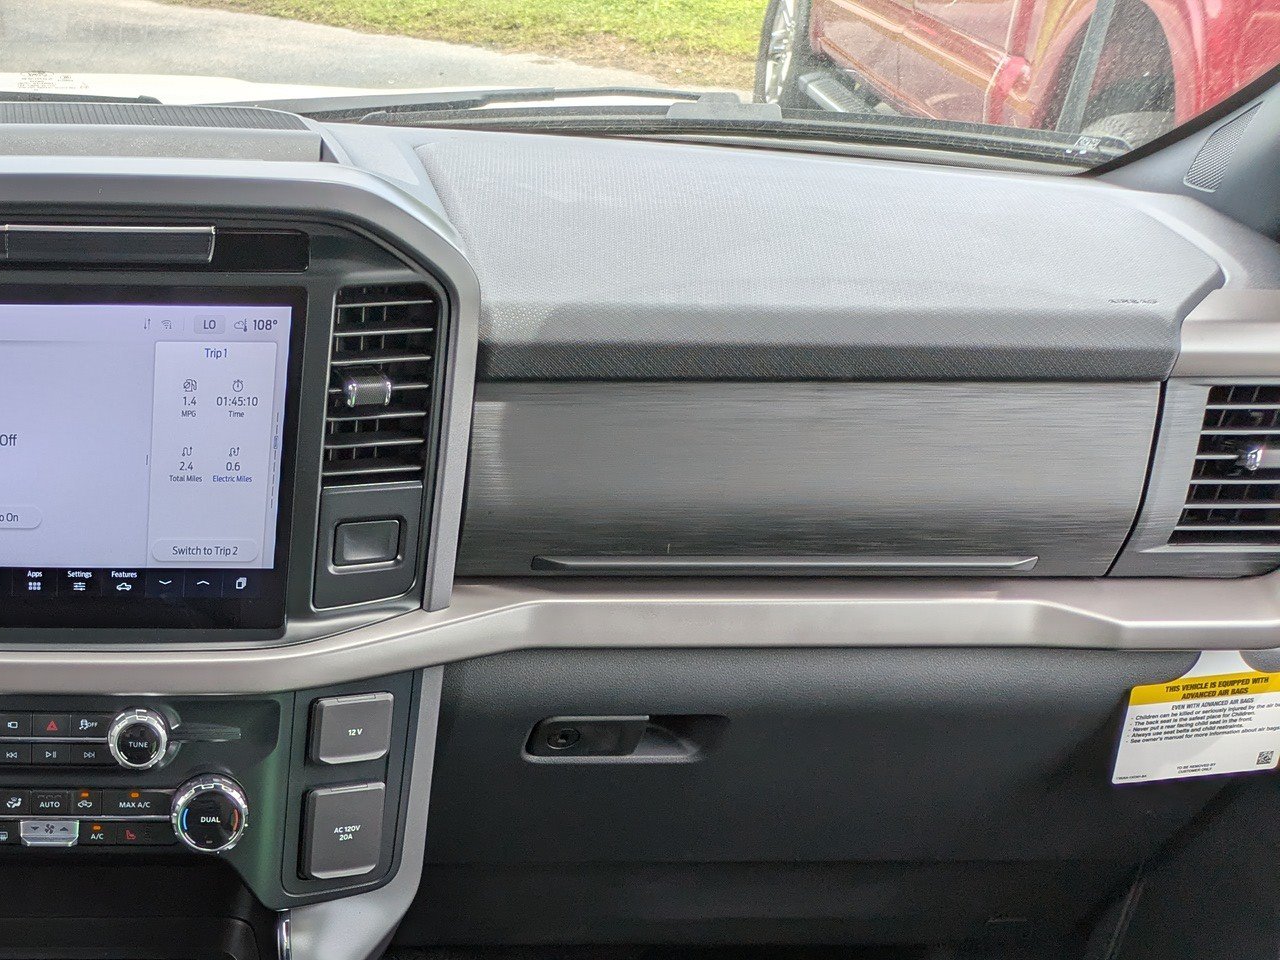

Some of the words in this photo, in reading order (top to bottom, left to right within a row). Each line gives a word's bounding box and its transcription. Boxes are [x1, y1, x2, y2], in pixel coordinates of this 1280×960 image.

[203, 319, 217, 330] LO
[253, 319, 278, 331] 108°
[204, 347, 222, 359] Trip
[223, 348, 228, 358] 1
[182, 396, 197, 406] 1.4
[216, 396, 259, 407] 01:45:10
[181, 410, 197, 418] MPG
[228, 410, 245, 418] Time
[0, 433, 18, 447] Off
[179, 461, 194, 471] 2.4
[225, 461, 241, 471] 0.6
[169, 474, 186, 482] Total
[186, 474, 203, 483] Miles
[212, 475, 236, 483] Electric
[236, 475, 253, 483] Miles
[6, 512, 19, 522] On
[172, 545, 202, 556] Switch
[203, 546, 213, 556] to
[214, 546, 231, 557] Trip
[232, 546, 239, 556] 2
[27, 570, 43, 578] Apps
[67, 570, 93, 579] Settings
[111, 570, 138, 578] Features
[1182, 682, 1209, 691] VEHICLE
[1218, 678, 1251, 688] EQUIPPED
[1252, 676, 1269, 685] WITH
[1181, 690, 1217, 700] ADVANCED
[1231, 687, 1249, 695] BAGS
[348, 728, 356, 736] 12
[333, 826, 344, 834] AC
[339, 833, 354, 841] 20A
